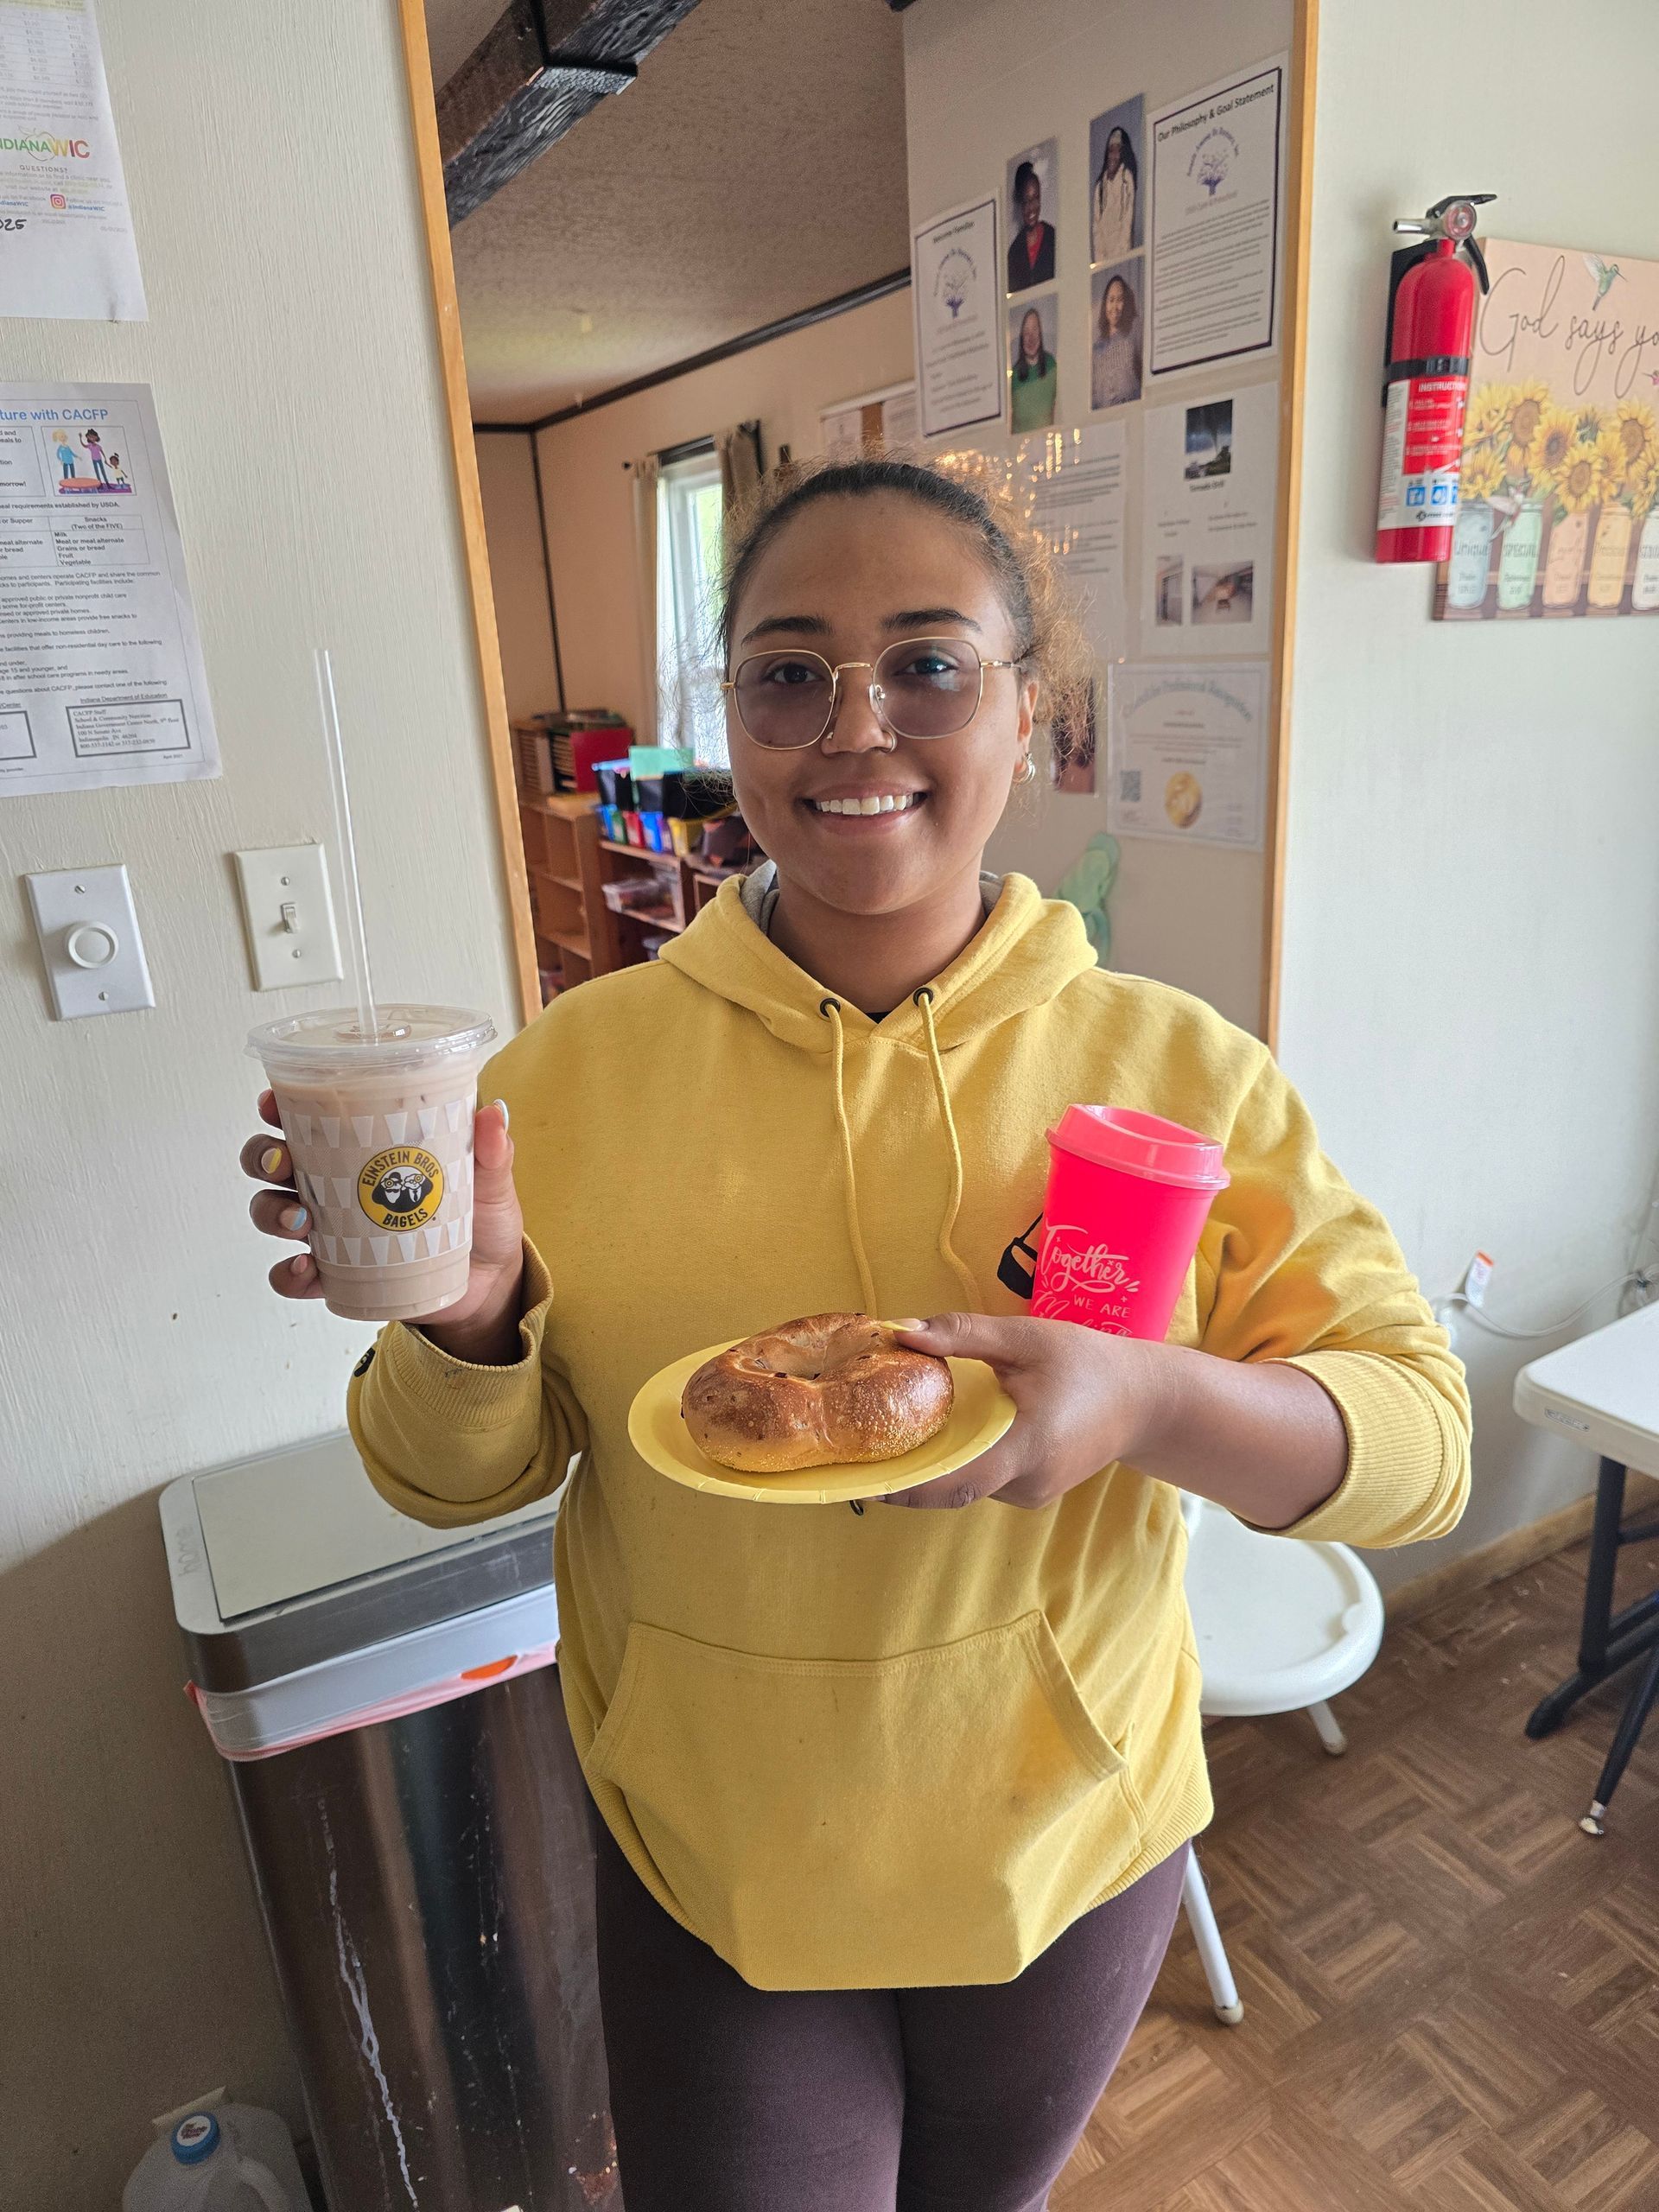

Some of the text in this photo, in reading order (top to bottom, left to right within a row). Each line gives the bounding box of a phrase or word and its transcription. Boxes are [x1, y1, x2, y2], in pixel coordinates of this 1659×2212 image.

[1157, 84, 1274, 142] Our Philosophy & Goal Statement
[19, 165, 68, 173] QUESTIONS?
[1479, 255, 1560, 372] God
[1565, 315, 1624, 396] says
[30, 409, 59, 420] with
[62, 409, 108, 421] CACFP
[101, 694, 133, 703] Department
[362, 1152, 439, 1186] EINSTEIN BROS
[382, 1208, 429, 1227] BAGELS
[1041, 1217, 1129, 1293] Together
[1074, 1294, 1093, 1310] WE
[1100, 1303, 1131, 1318] ARE
